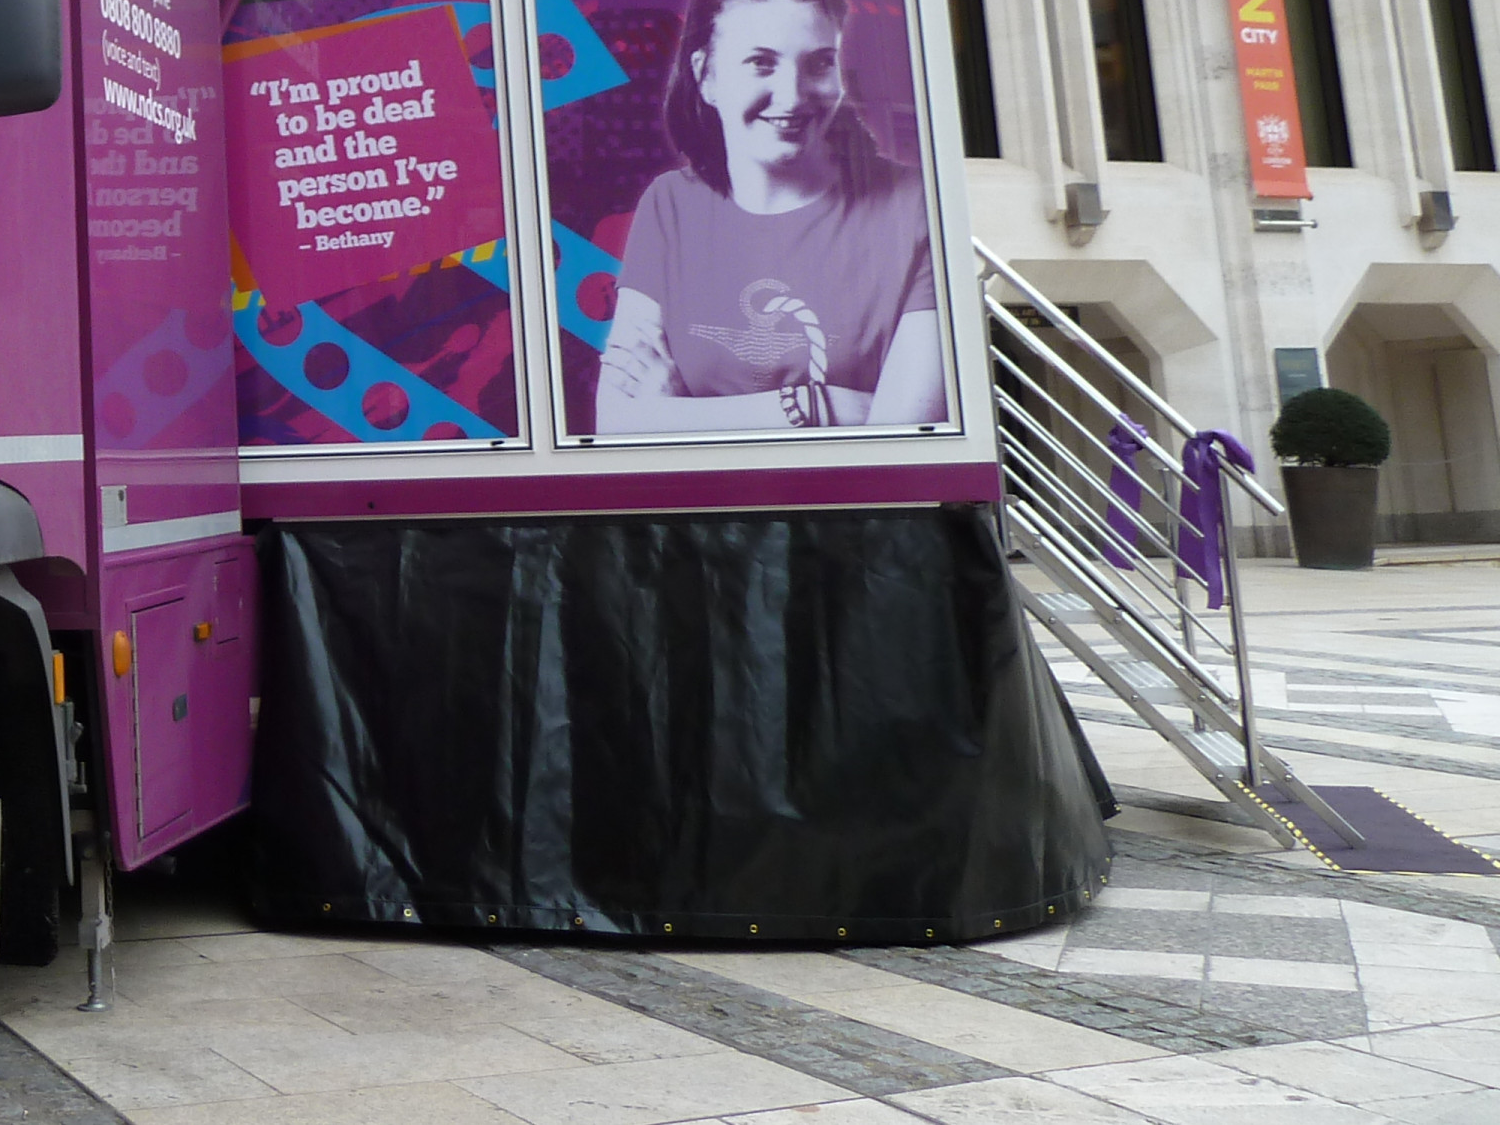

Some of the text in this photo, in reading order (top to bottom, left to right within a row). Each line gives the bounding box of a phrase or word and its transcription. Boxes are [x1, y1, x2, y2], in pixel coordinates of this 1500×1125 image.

[102, 29, 127, 66] (voice
[126, 49, 142, 75] and
[131, 4, 154, 44] 800
[153, 17, 182, 60] 8880
[1240, 27, 1279, 45] CITY
[327, 59, 424, 105] proud
[103, 77, 197, 145] www.ndcs.org.uk
[276, 89, 436, 136] to be deaf
[275, 131, 397, 168] and the
[278, 166, 389, 206] person
[315, 230, 395, 251] Bethany
